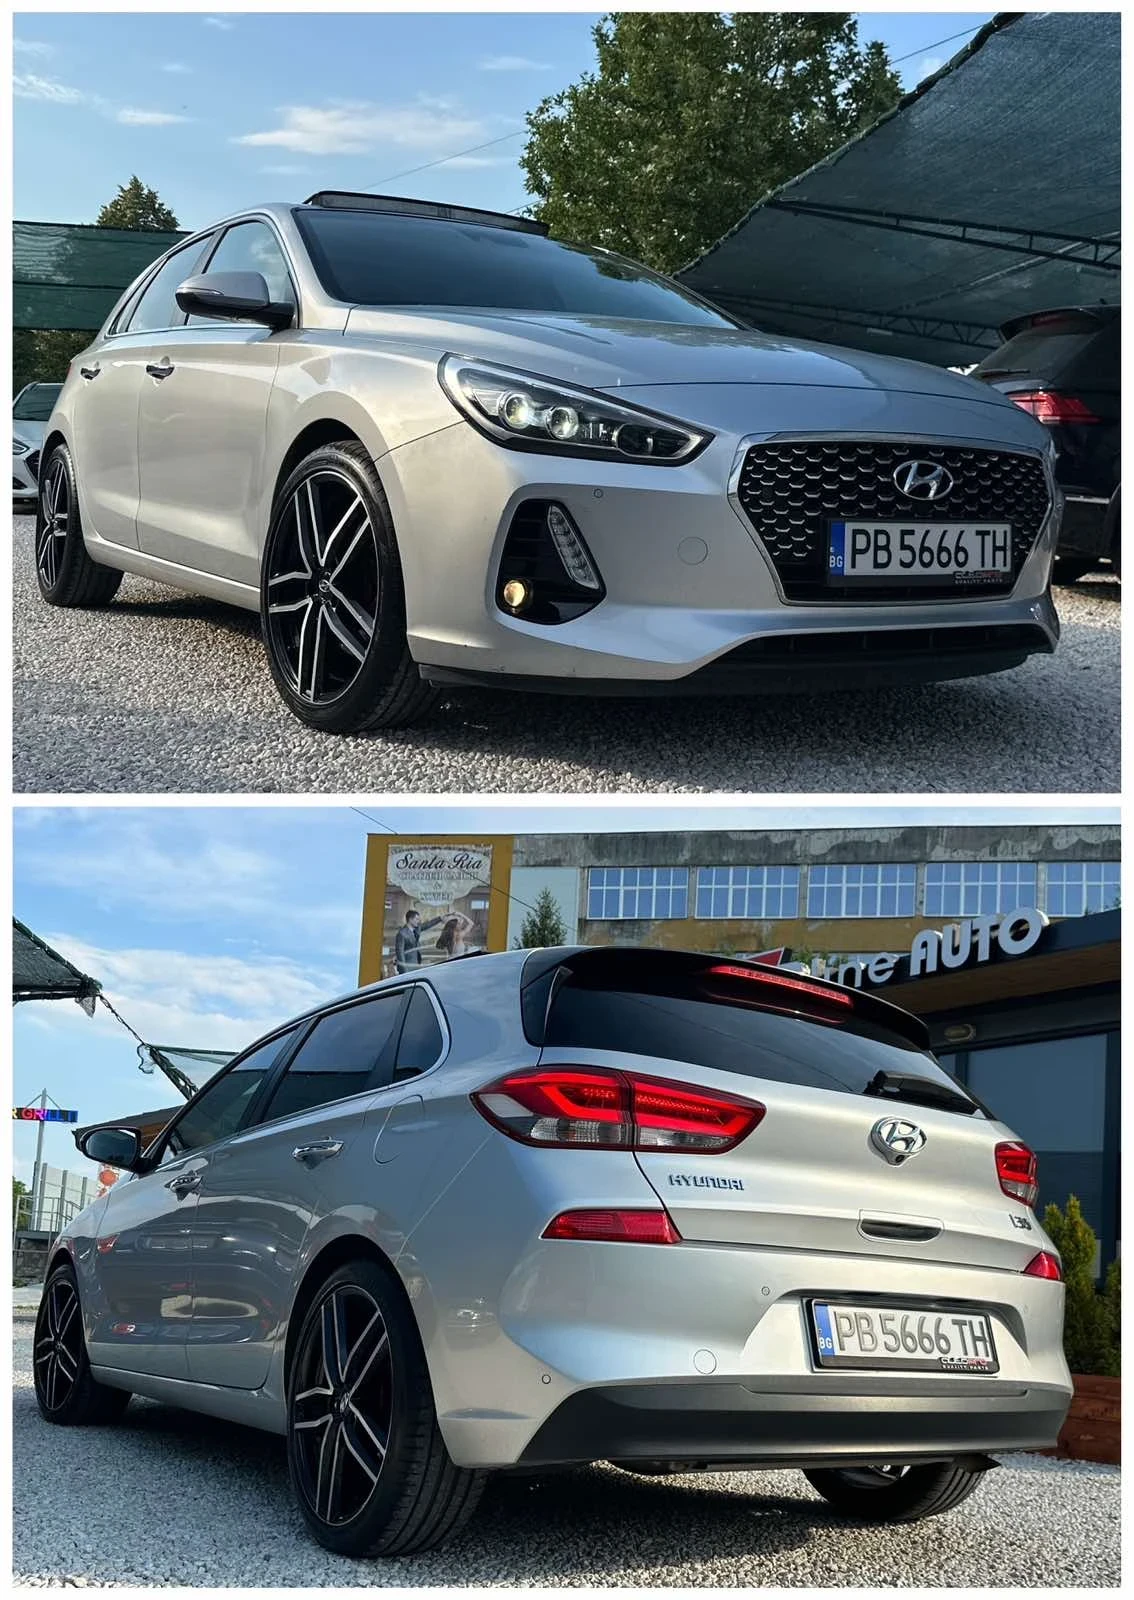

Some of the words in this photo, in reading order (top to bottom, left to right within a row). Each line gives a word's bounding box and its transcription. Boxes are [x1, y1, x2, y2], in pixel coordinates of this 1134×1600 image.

[851, 528, 892, 569] PB
[899, 529, 970, 569] 5666
[975, 529, 1008, 568] TH
[829, 555, 843, 568] BG
[396, 852, 445, 870] Santa
[447, 852, 482, 870] Ria
[910, 906, 1045, 977] AUTO
[22, 1107, 65, 1122] GRILL
[668, 1174, 744, 1191] HYUNDAI
[833, 1311, 878, 1352] PB
[879, 1313, 951, 1354] 5666
[951, 1318, 990, 1358] TH
[818, 1337, 833, 1350] BG
